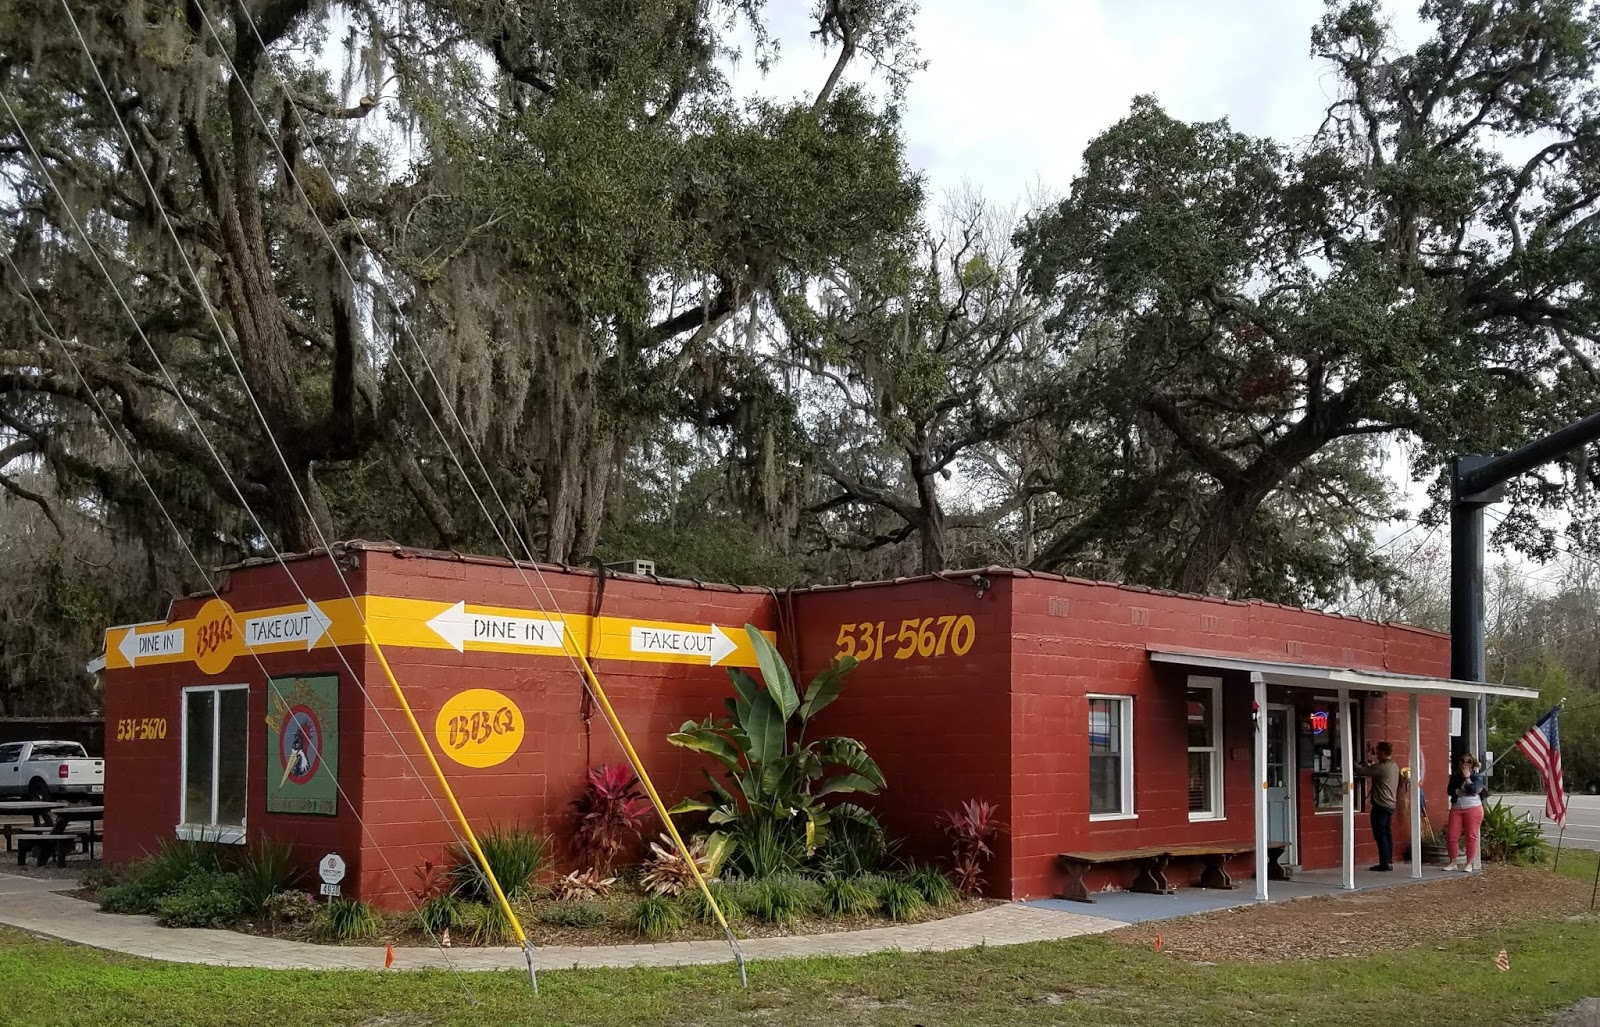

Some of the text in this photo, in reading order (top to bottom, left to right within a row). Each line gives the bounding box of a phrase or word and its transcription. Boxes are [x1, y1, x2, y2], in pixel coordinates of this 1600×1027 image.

[196, 614, 233, 658] BBQ
[251, 616, 312, 641] TAKE OUT
[474, 619, 544, 641] DINE IN
[834, 614, 976, 661] 531-5670
[139, 633, 174, 654] DINE IN
[640, 631, 717, 652] TAKE OUT
[117, 717, 167, 741] 531-5670
[448, 706, 516, 750] BBQ
